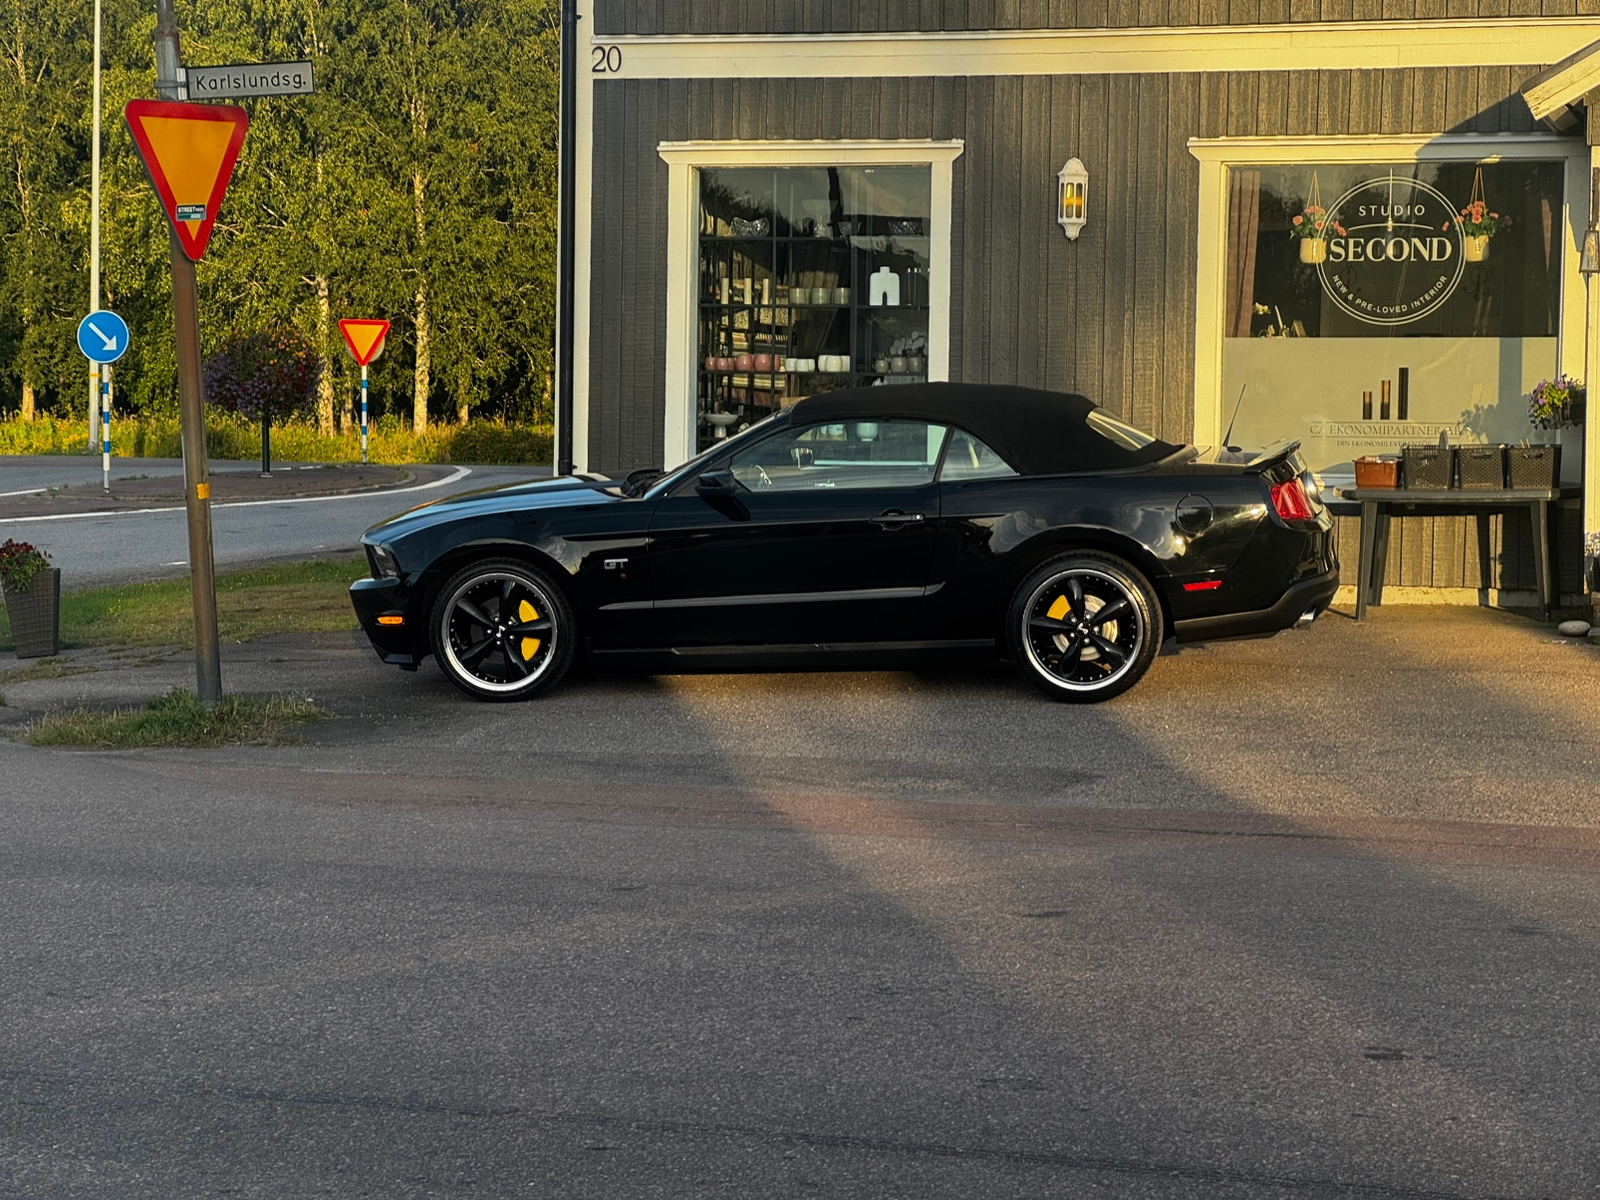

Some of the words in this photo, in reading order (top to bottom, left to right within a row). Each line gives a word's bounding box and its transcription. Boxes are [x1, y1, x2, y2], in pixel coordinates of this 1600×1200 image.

[592, 46, 622, 72] 20
[196, 71, 307, 91] Karlslundsg.
[1358, 204, 1426, 217] STUDIO
[1329, 237, 1452, 262] SECOND
[1332, 274, 1348, 295] NEW
[1347, 293, 1354, 301] &
[1355, 298, 1408, 314] PRE-LOVED
[1411, 275, 1448, 309] INTERIOR
[1329, 424, 1440, 436] EKONOMIPARTNER
[1336, 439, 1351, 447] DIN
[603, 558, 629, 570] GT
